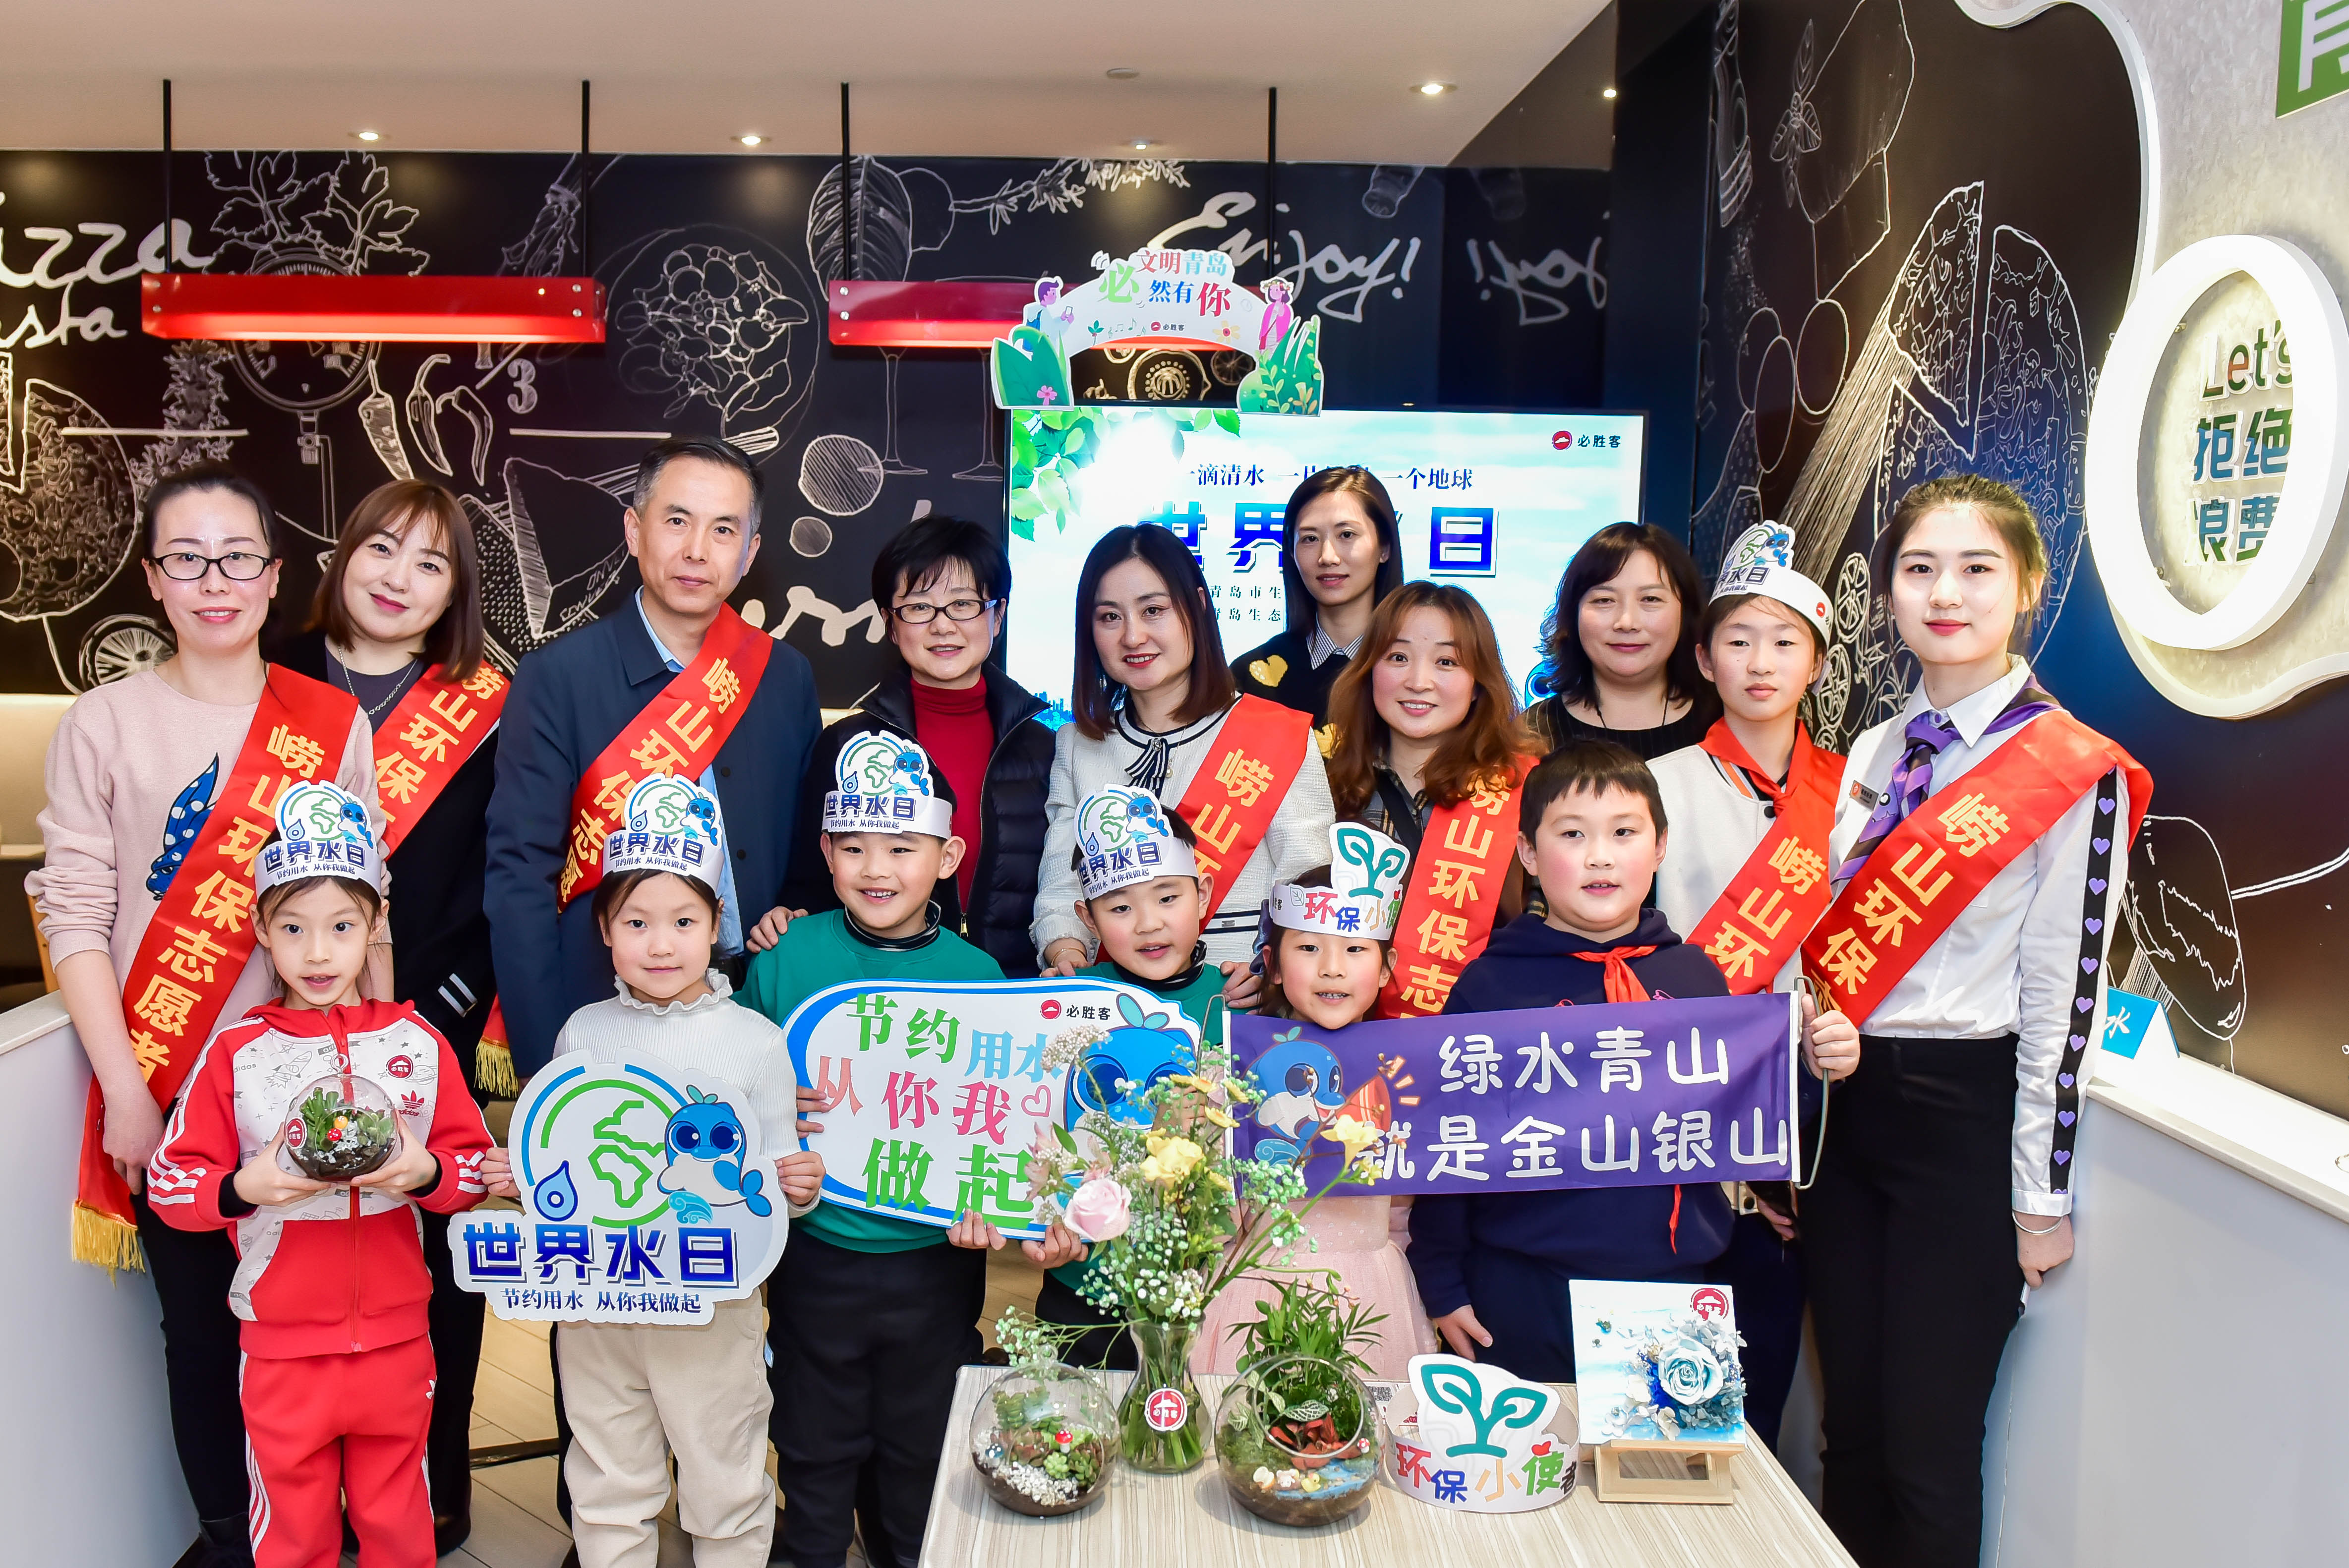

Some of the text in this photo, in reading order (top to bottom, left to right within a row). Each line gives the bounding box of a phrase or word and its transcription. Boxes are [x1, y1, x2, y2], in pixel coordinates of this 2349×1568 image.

[1136, 250, 1227, 276] 文明青岛
[0, 282, 128, 348] sta
[1578, 434, 1621, 448] 必胜客
[2193, 407, 2293, 482] 拒绝
[1382, 467, 1473, 491] 一个地球
[558, 657, 741, 914] 崂山环保志愿
[825, 794, 916, 821] 世界水日
[264, 840, 366, 875] 世界水日
[609, 832, 705, 868] 世界水日
[1079, 841, 1162, 888] 世界水日
[1400, 774, 1511, 1018] 崂山环保志
[1704, 835, 1829, 993] 崂山环
[843, 993, 1063, 1083] 节约用水
[1066, 1004, 1111, 1020] 必胜客
[1439, 1026, 1729, 1094] 绿水青山
[817, 1055, 1012, 1146] 从你我
[1352, 1106, 1787, 1181] 就是金山银山
[861, 1137, 1035, 1230] 做起
[463, 1221, 739, 1288] 世界水日
[501, 1288, 702, 1314] 节约用水 从你我做起
[1396, 1442, 1577, 1504] 环保小使者
